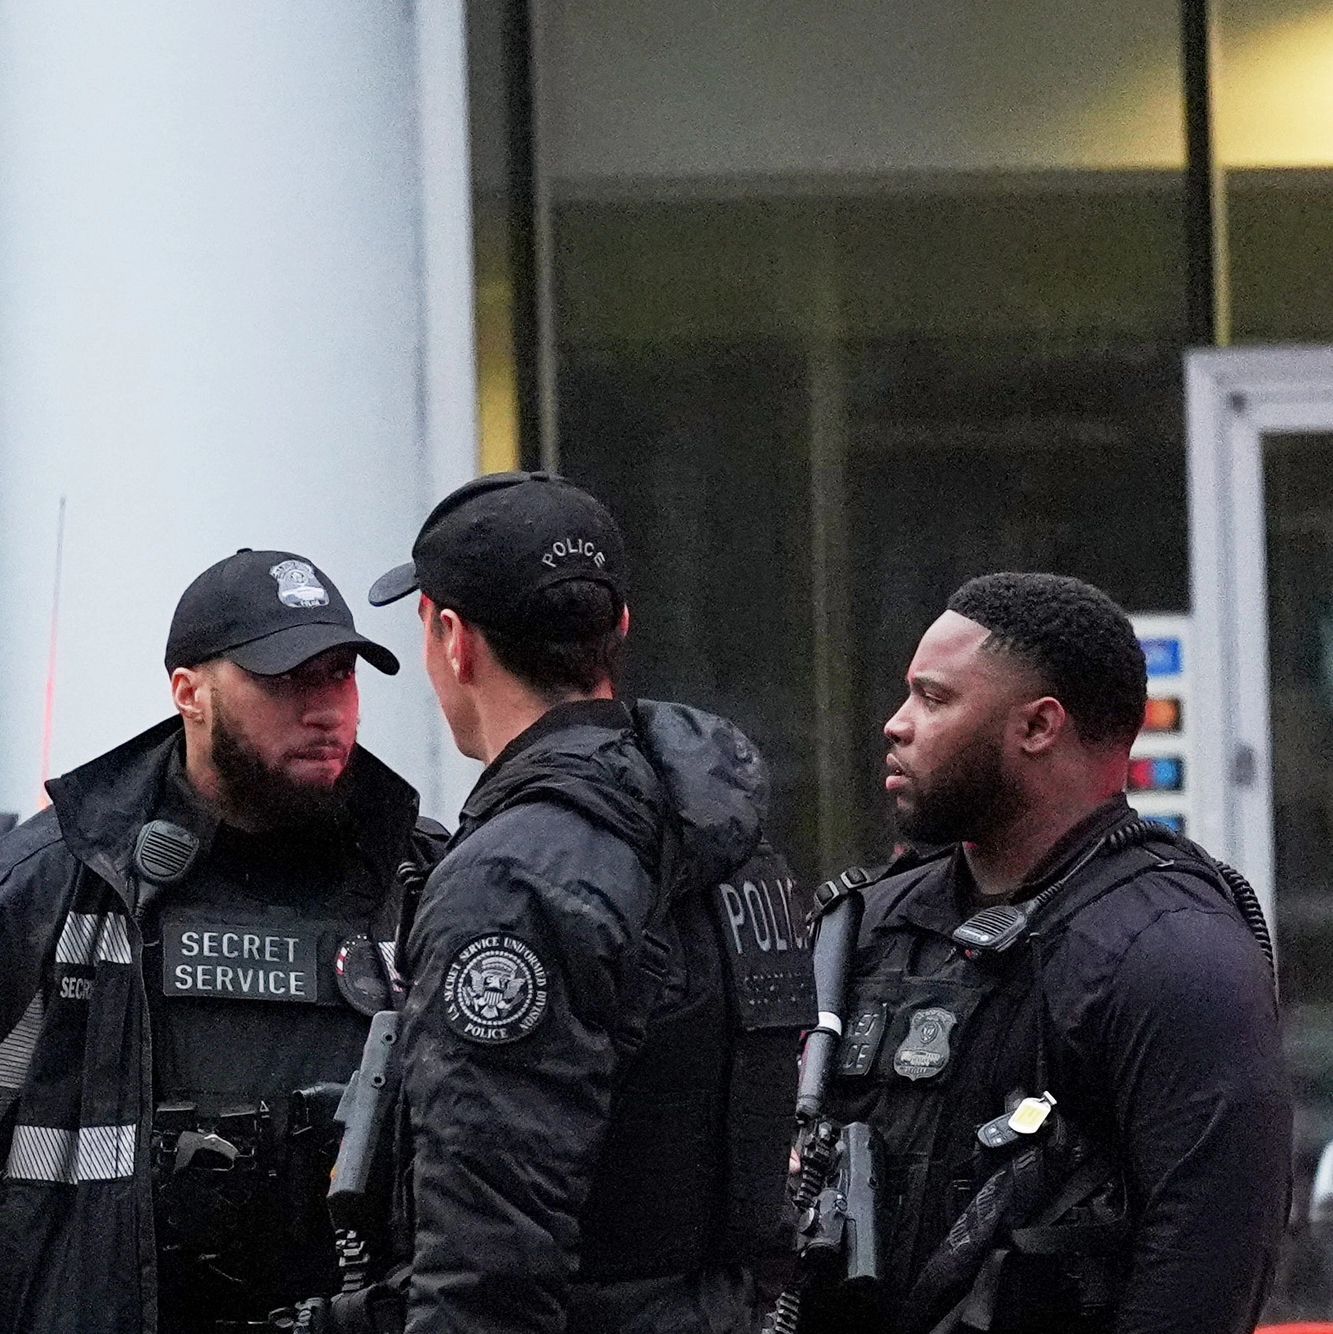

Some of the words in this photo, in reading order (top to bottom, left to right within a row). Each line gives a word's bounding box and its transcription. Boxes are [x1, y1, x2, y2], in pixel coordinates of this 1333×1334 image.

[542, 538, 606, 568] POLICE
[719, 876, 809, 955] POLI
[181, 931, 299, 963] SECRET
[175, 965, 306, 996] SERVICE
[444, 962, 461, 1002] SECRET
[459, 937, 500, 961] SERVICE
[503, 937, 547, 987] UNIFORMED
[60, 976, 93, 1000] SECR
[464, 1022, 509, 1039] POLICE
